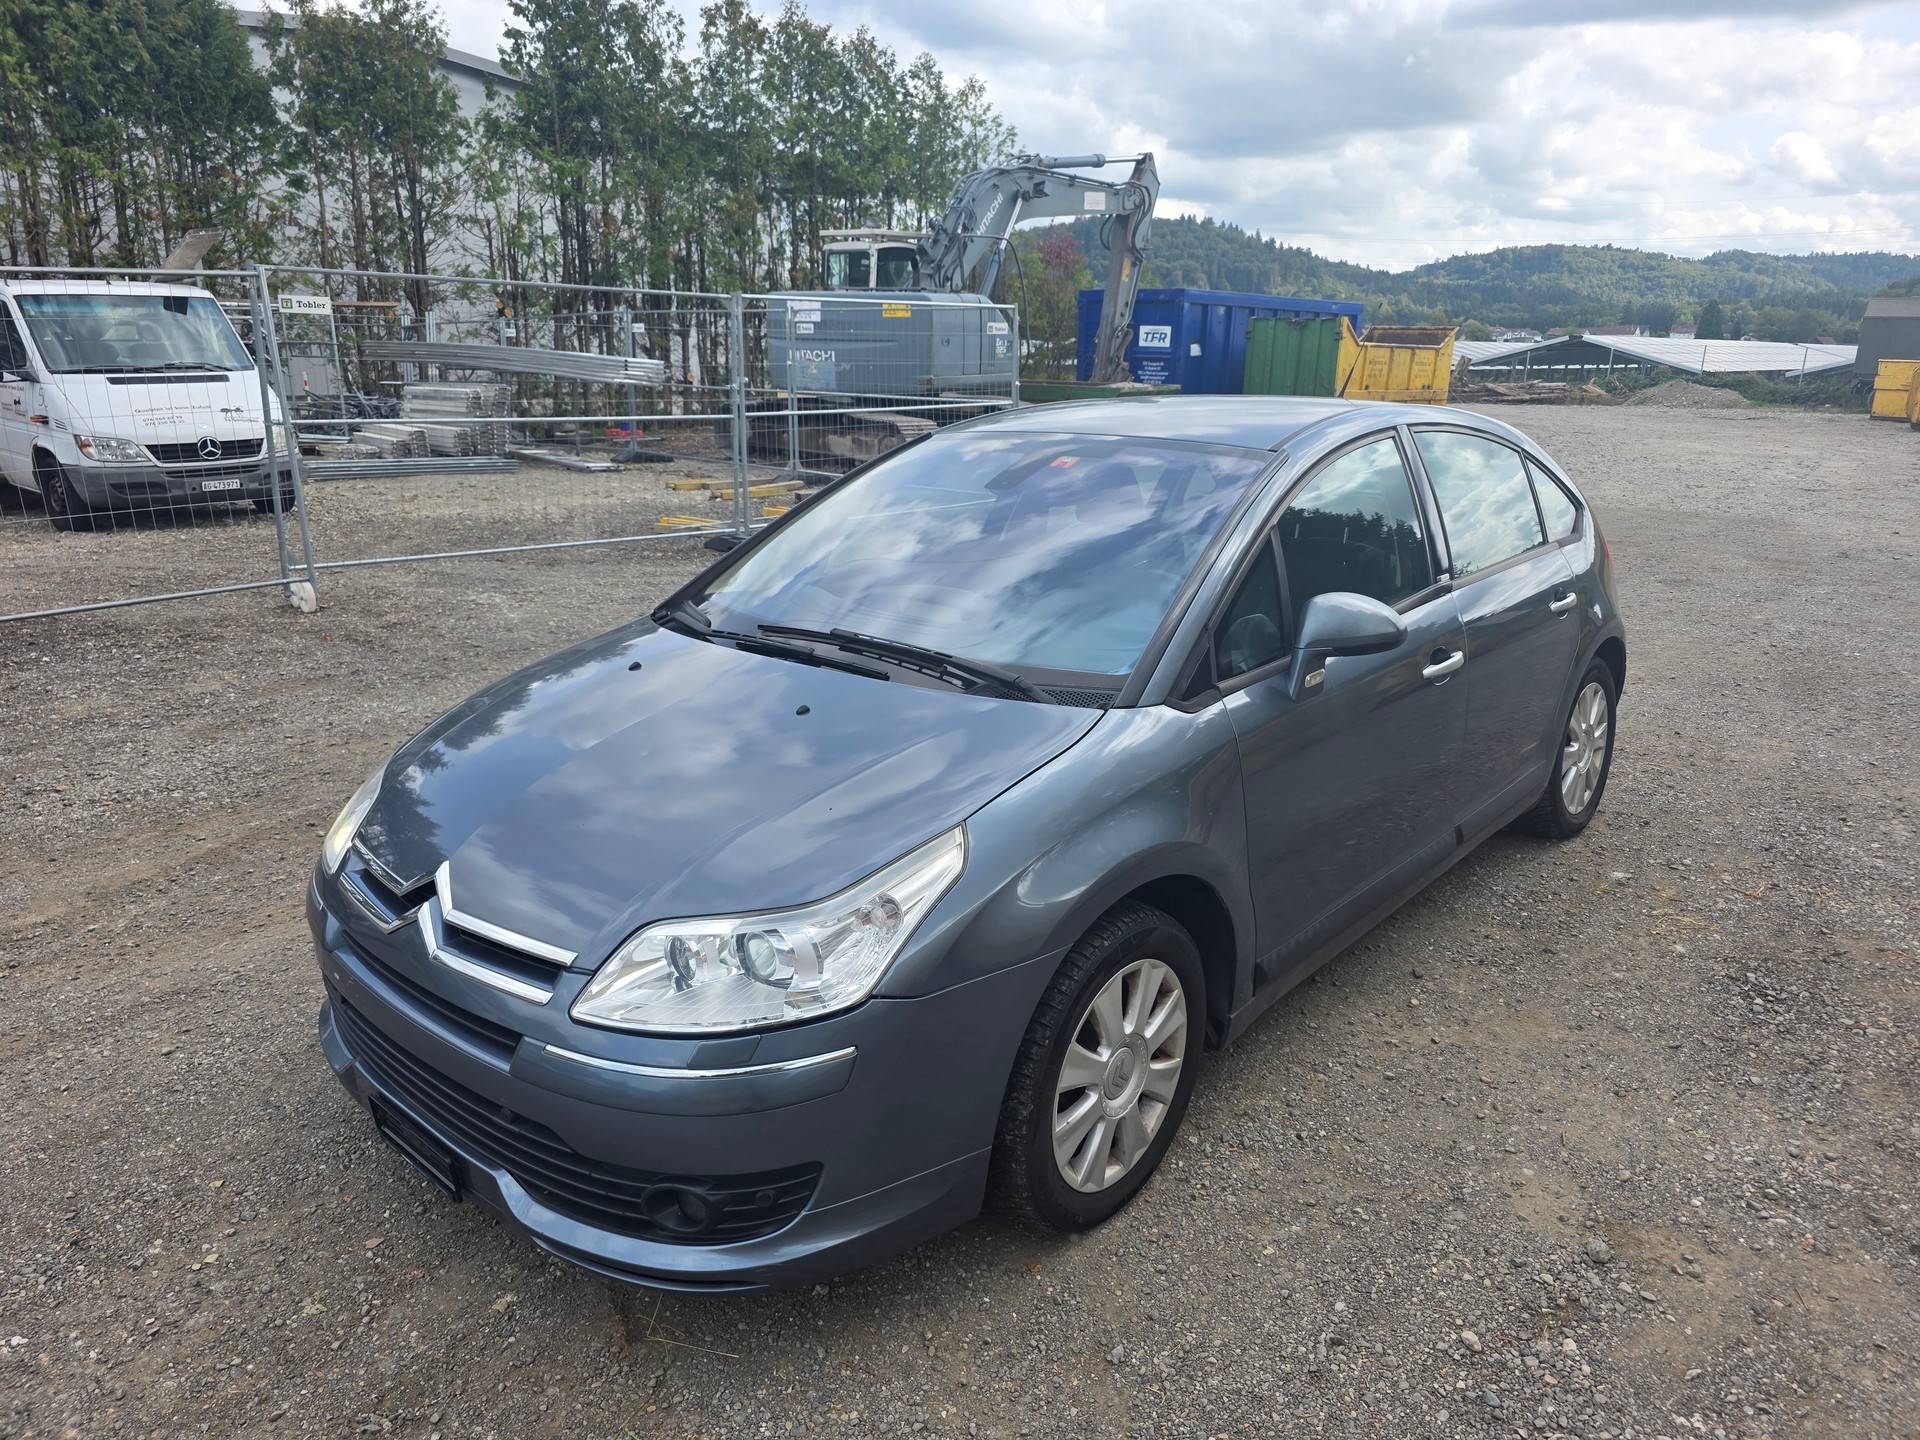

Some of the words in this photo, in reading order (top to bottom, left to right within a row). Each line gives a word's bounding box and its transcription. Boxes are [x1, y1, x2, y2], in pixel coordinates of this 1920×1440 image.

[976, 192, 1003, 236] HITACHI
[296, 300, 326, 309] Tobler
[1143, 331, 1168, 343] TFR
